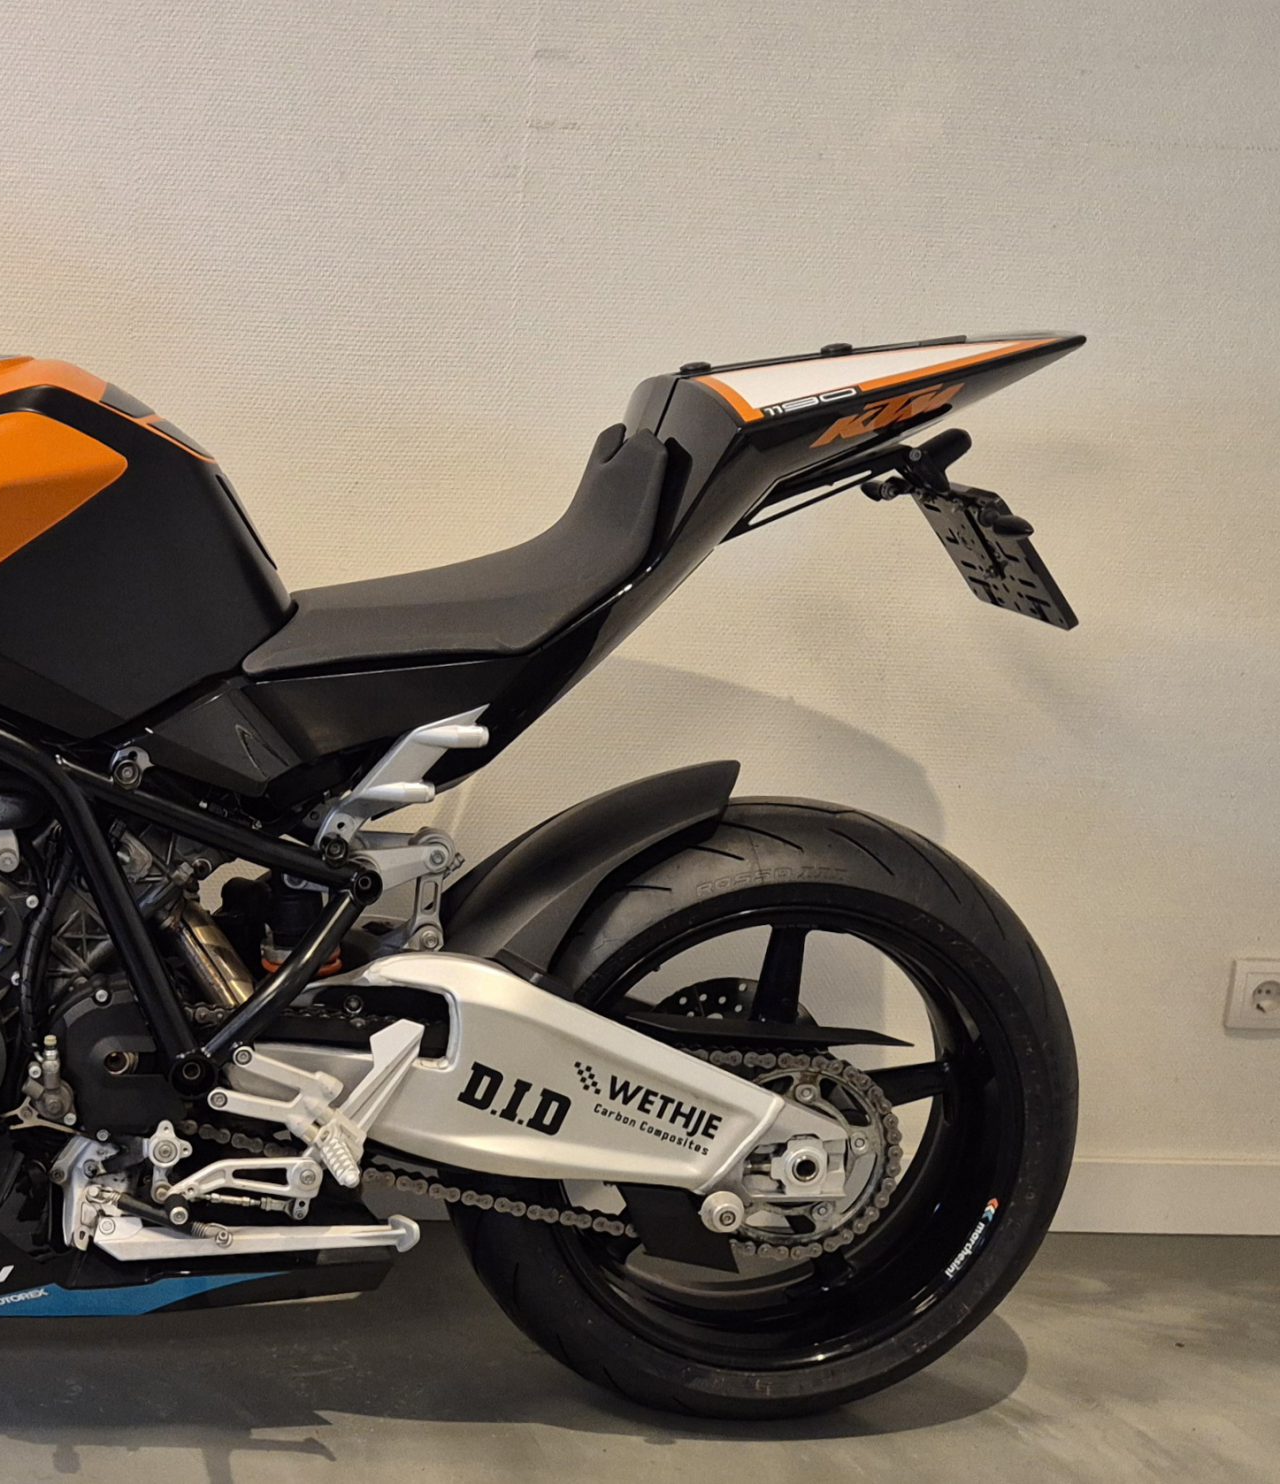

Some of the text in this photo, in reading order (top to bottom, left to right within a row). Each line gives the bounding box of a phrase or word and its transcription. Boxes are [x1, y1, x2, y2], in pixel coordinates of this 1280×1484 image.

[764, 387, 858, 417] 1190
[809, 382, 965, 449] KTM
[457, 1061, 572, 1137] D.I.D
[593, 1103, 710, 1157] Carbon Composites
[609, 1075, 723, 1140] WETHJE
